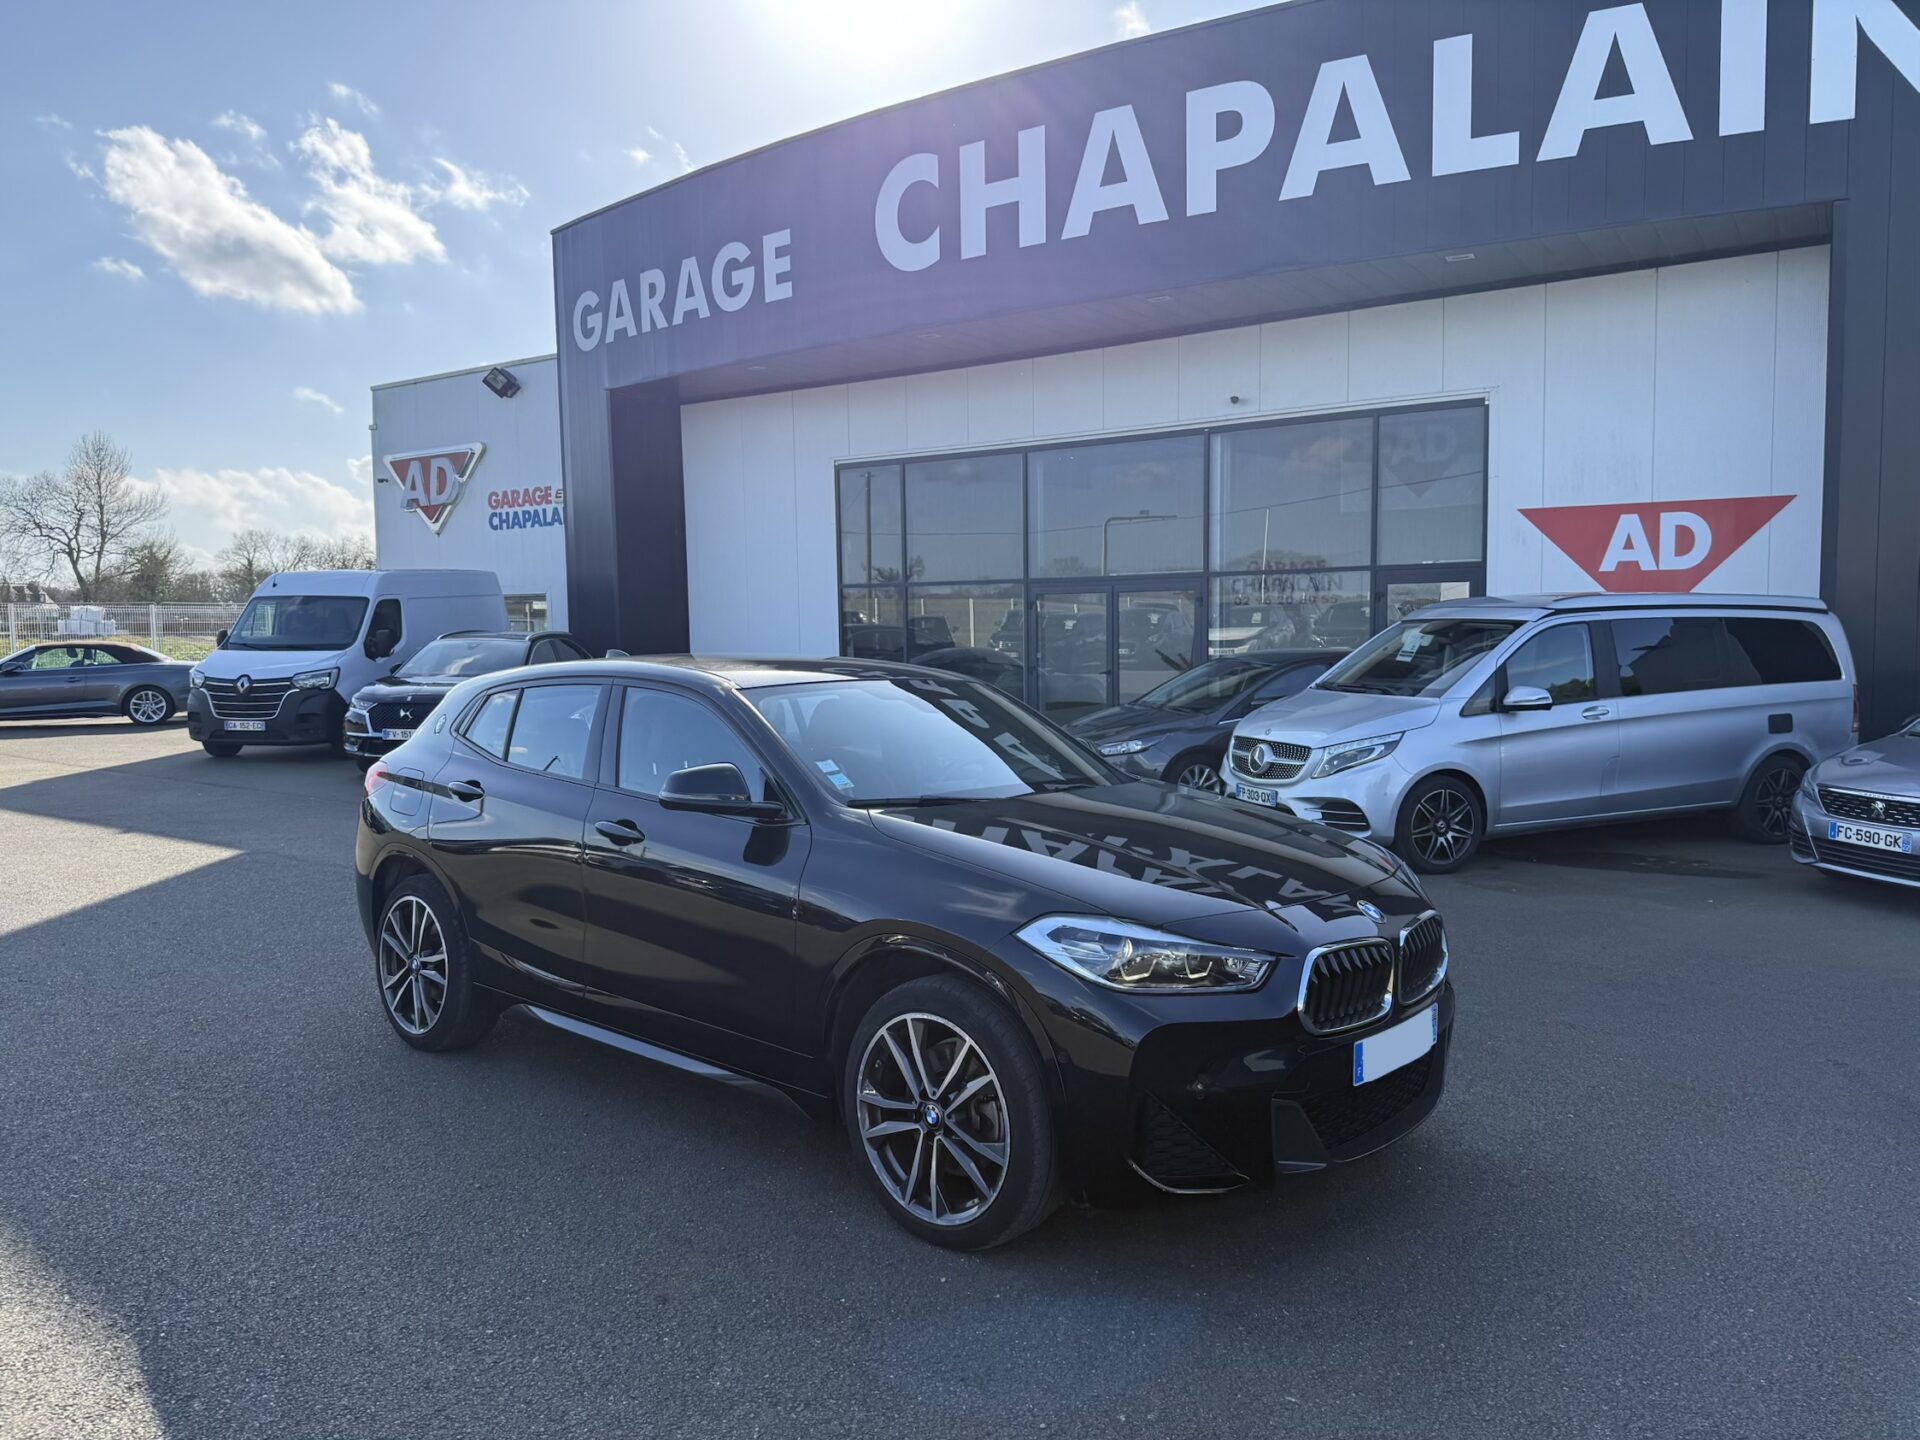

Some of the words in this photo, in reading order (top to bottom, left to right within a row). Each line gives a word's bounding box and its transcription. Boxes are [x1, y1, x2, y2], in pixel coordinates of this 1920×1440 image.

[573, 228, 793, 352] GARAGE
[401, 456, 458, 508] AD
[488, 486, 552, 510] GARAGE
[1599, 511, 1713, 572] AD
[1836, 824, 1902, 849] FC-590-GK
